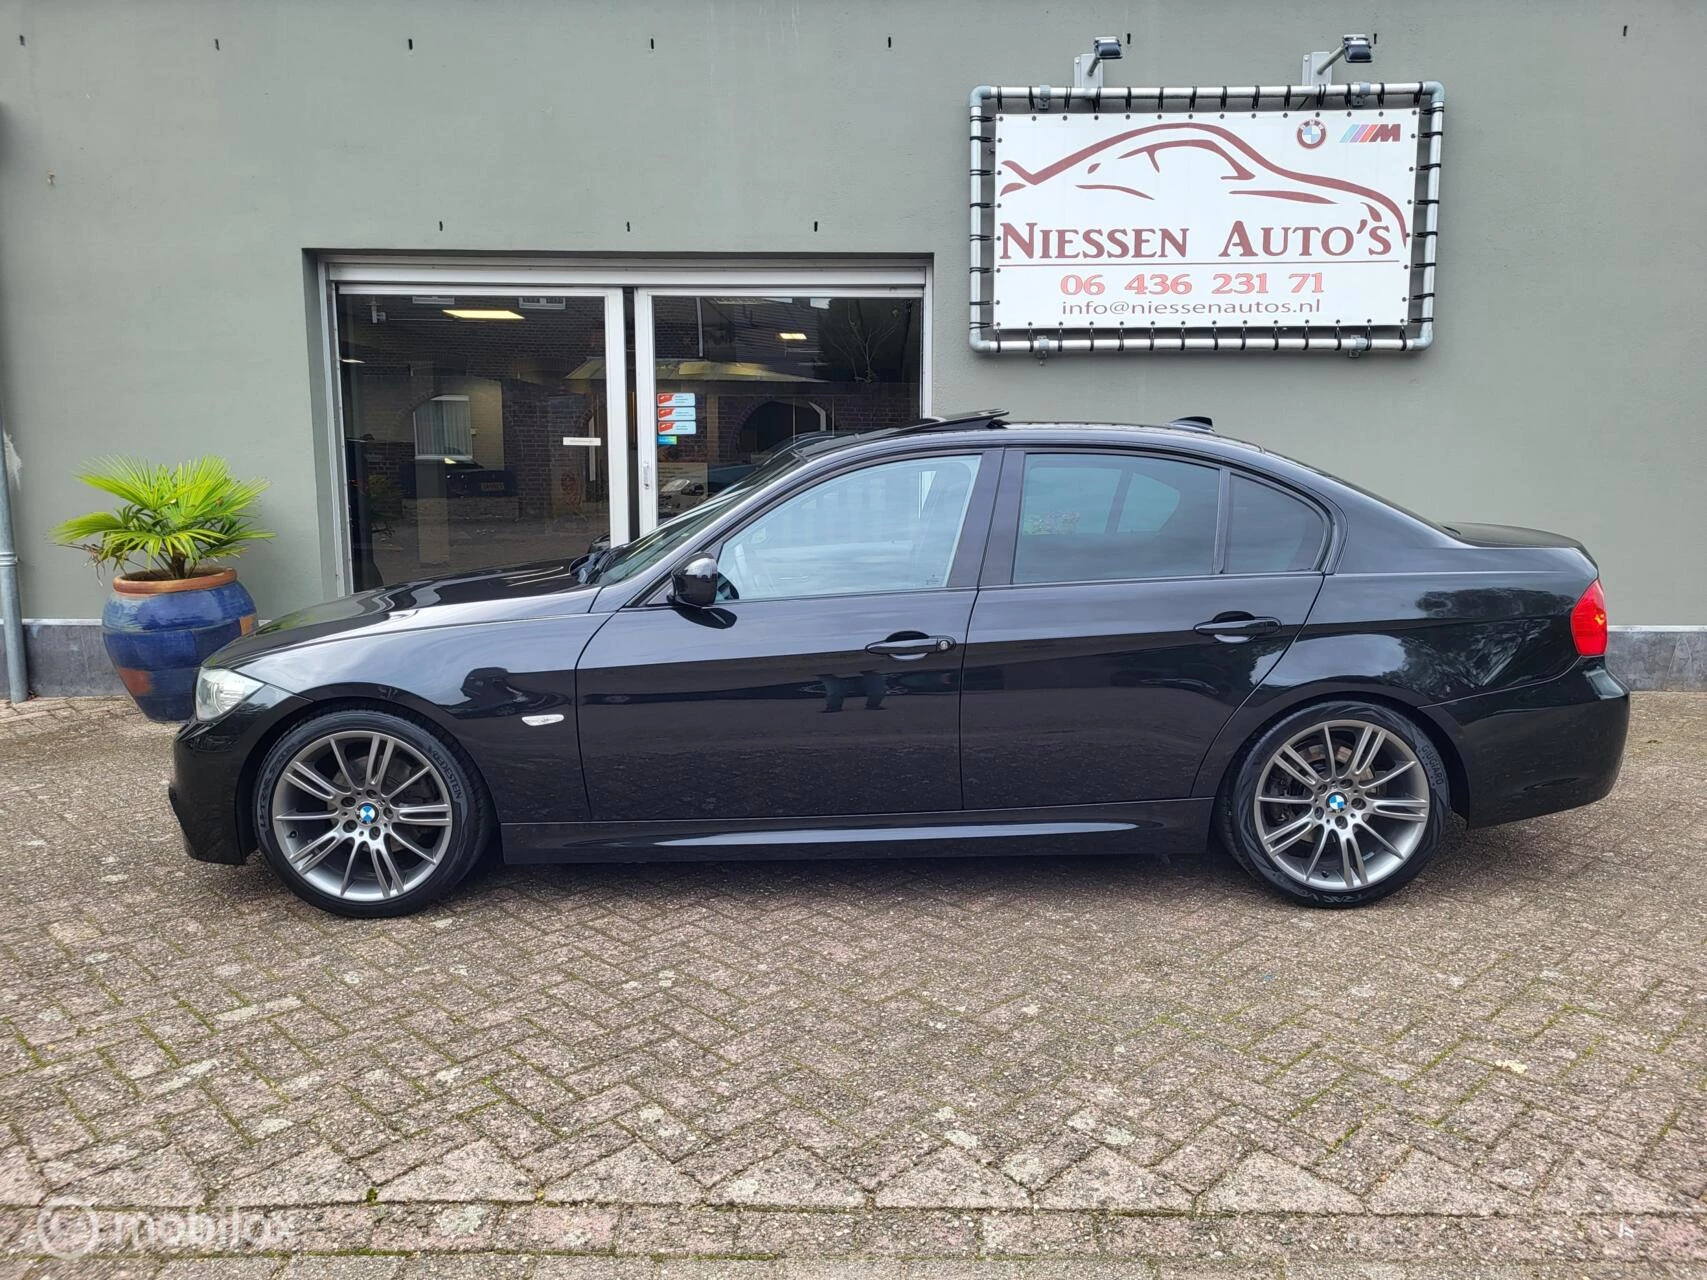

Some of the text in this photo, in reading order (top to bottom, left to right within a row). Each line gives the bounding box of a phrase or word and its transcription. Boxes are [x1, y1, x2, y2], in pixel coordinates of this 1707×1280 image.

[1000, 219, 1392, 259] NIESSEN AUTO'S
[1060, 272, 1324, 295] 06 436 231 71
[1062, 299, 1320, 314] info@niessenautos.nl
